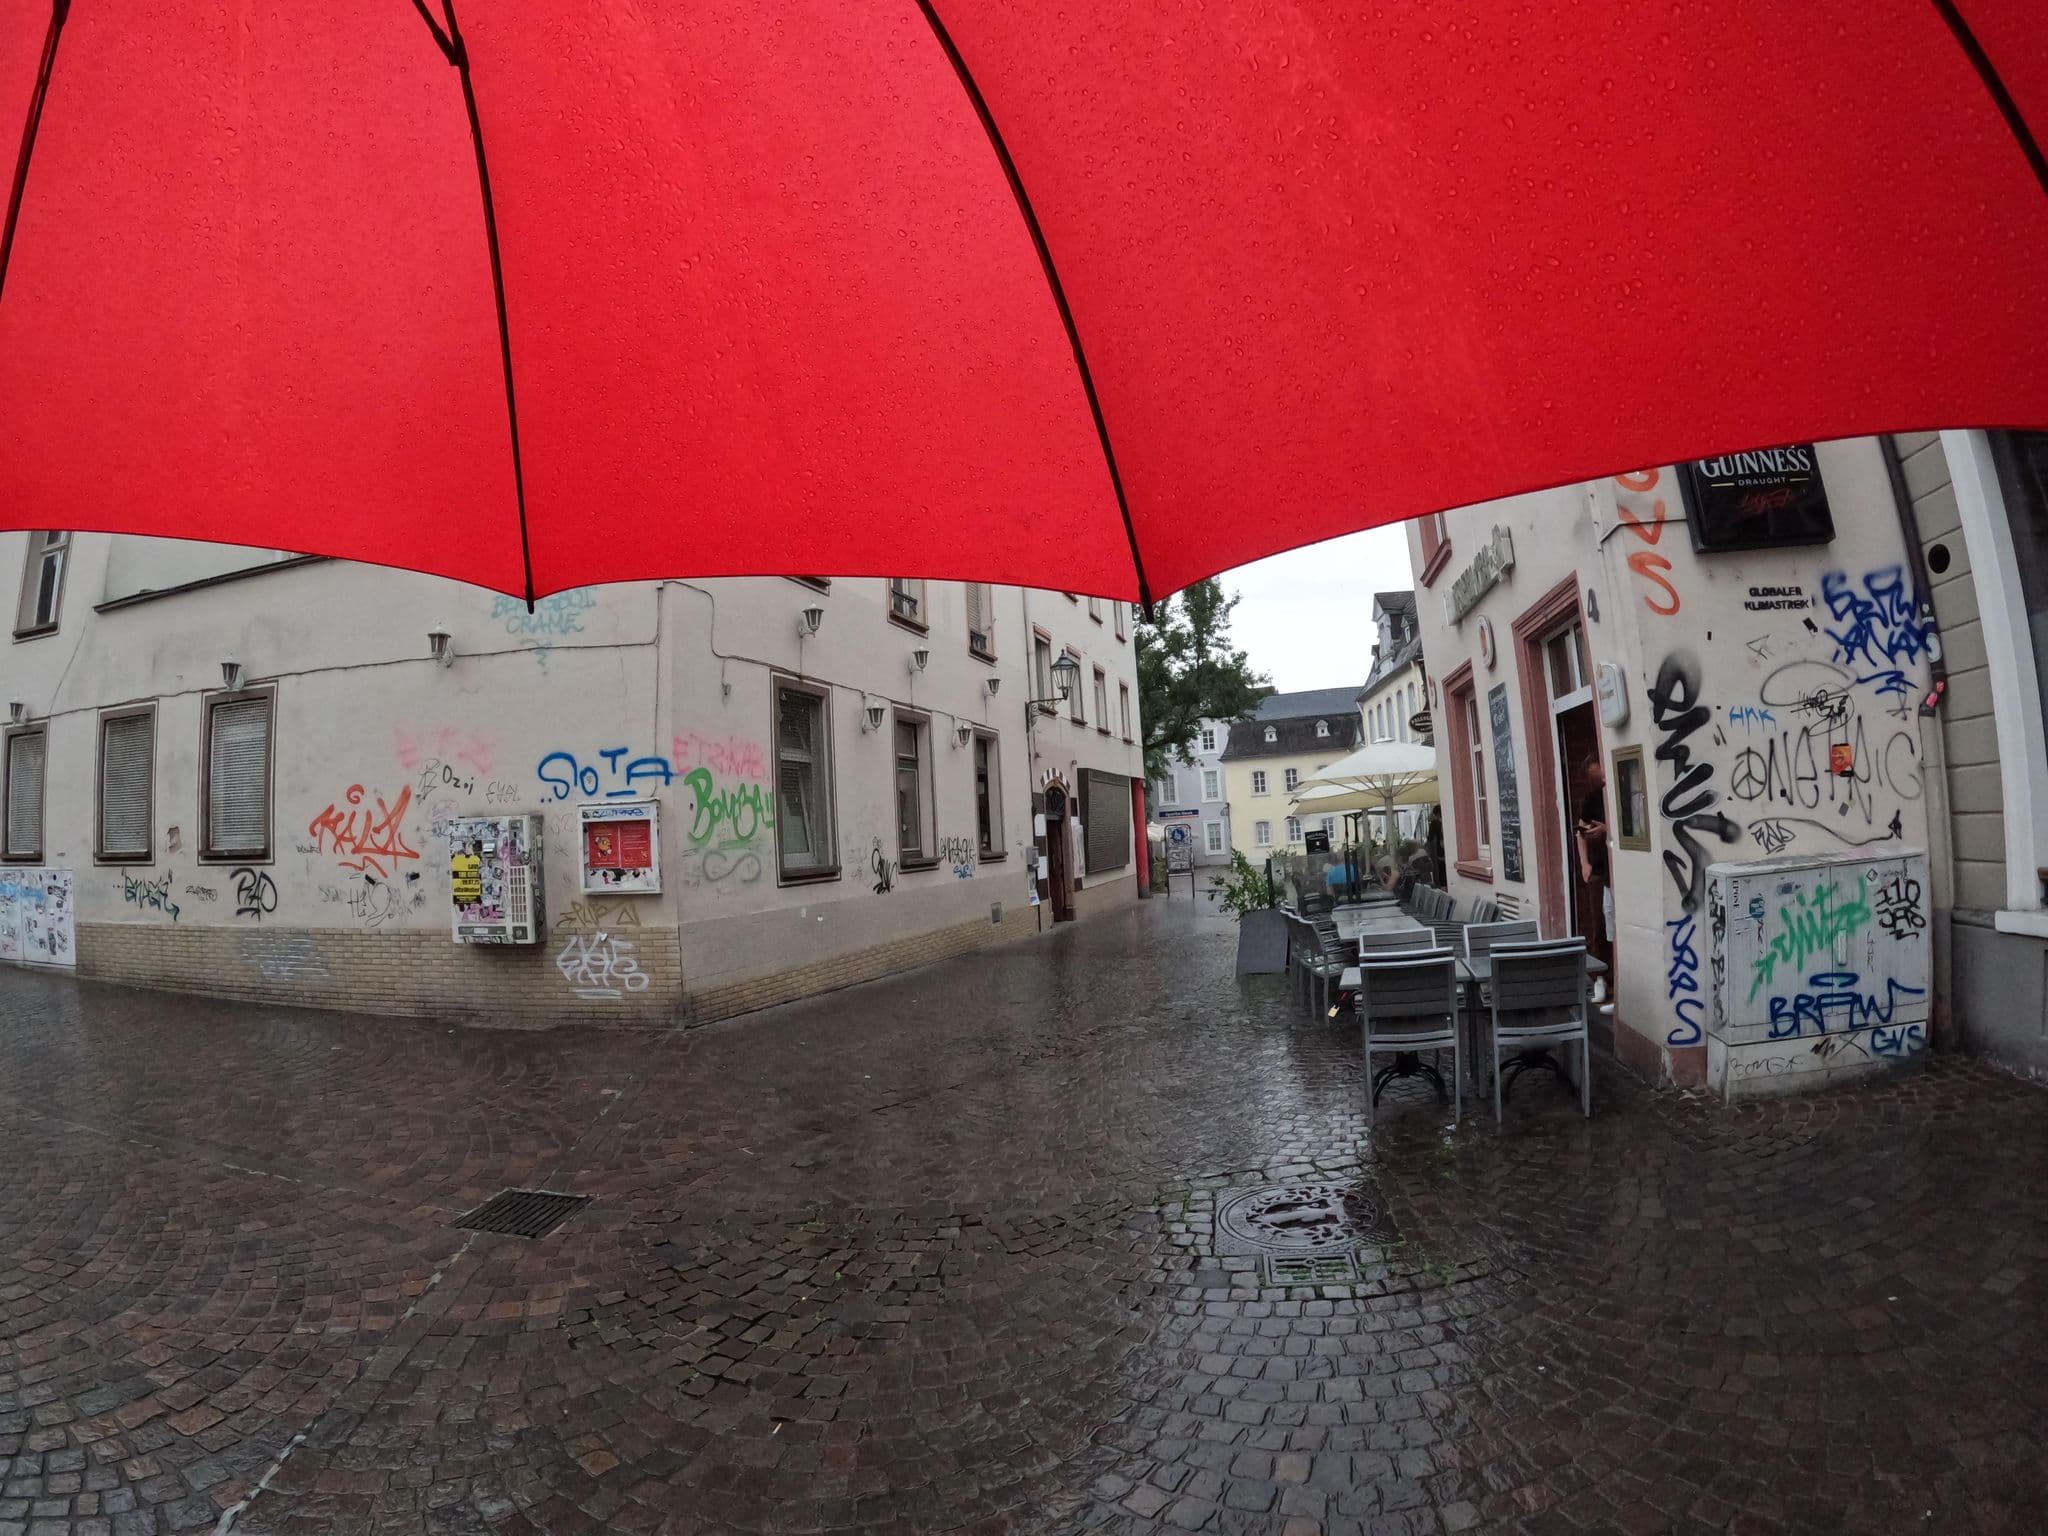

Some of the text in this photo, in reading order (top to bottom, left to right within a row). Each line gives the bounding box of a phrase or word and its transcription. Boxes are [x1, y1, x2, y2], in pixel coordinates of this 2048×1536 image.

[1699, 447, 1811, 478] GUINNESS
[1738, 476, 1787, 487] DRAUGHT
[1749, 586, 1803, 597] GLOBALER
